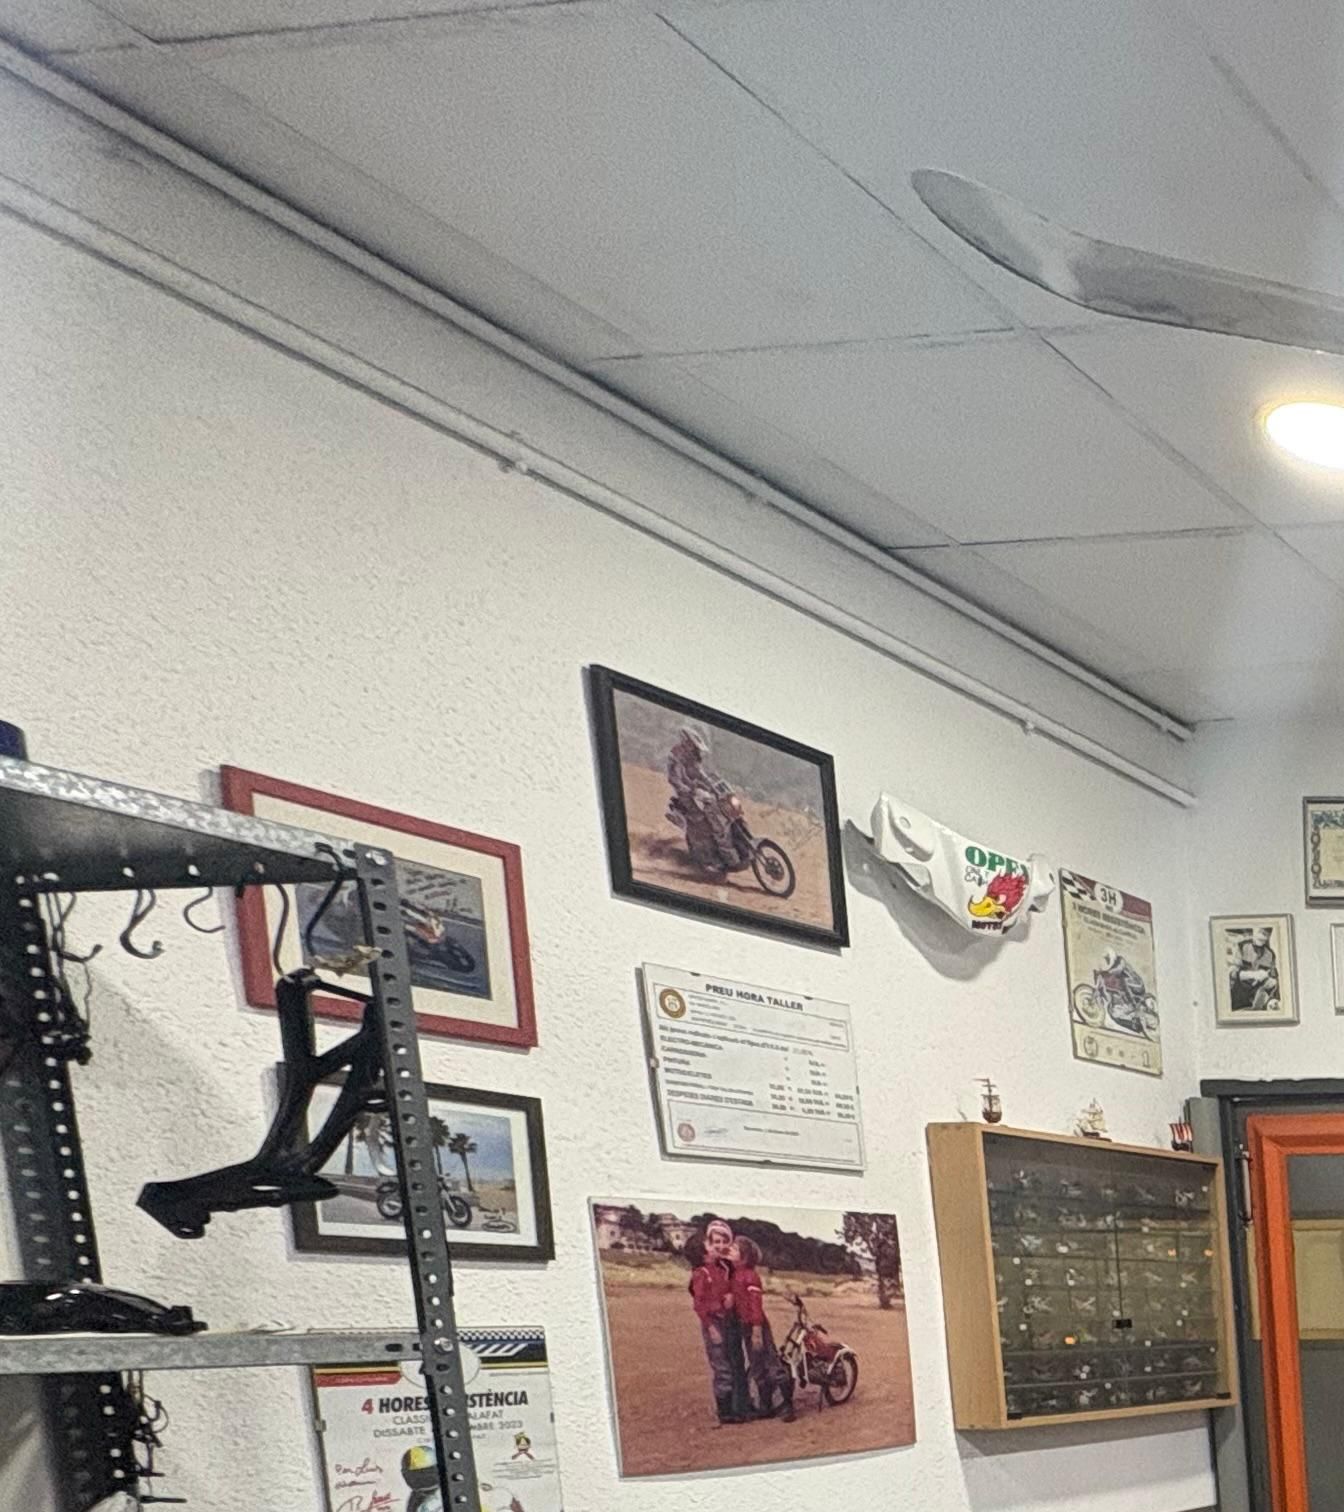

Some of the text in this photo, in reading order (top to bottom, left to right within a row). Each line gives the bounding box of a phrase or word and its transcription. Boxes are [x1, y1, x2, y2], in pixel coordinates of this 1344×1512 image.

[1100, 888, 1116, 906] 3H
[705, 984, 734, 997] PREU
[766, 996, 804, 1011] TALLER
[361, 1398, 374, 1414] 4
[379, 1397, 429, 1414] HORES
[373, 1427, 426, 1438] DISSABTE
[499, 1420, 523, 1430] 2023
